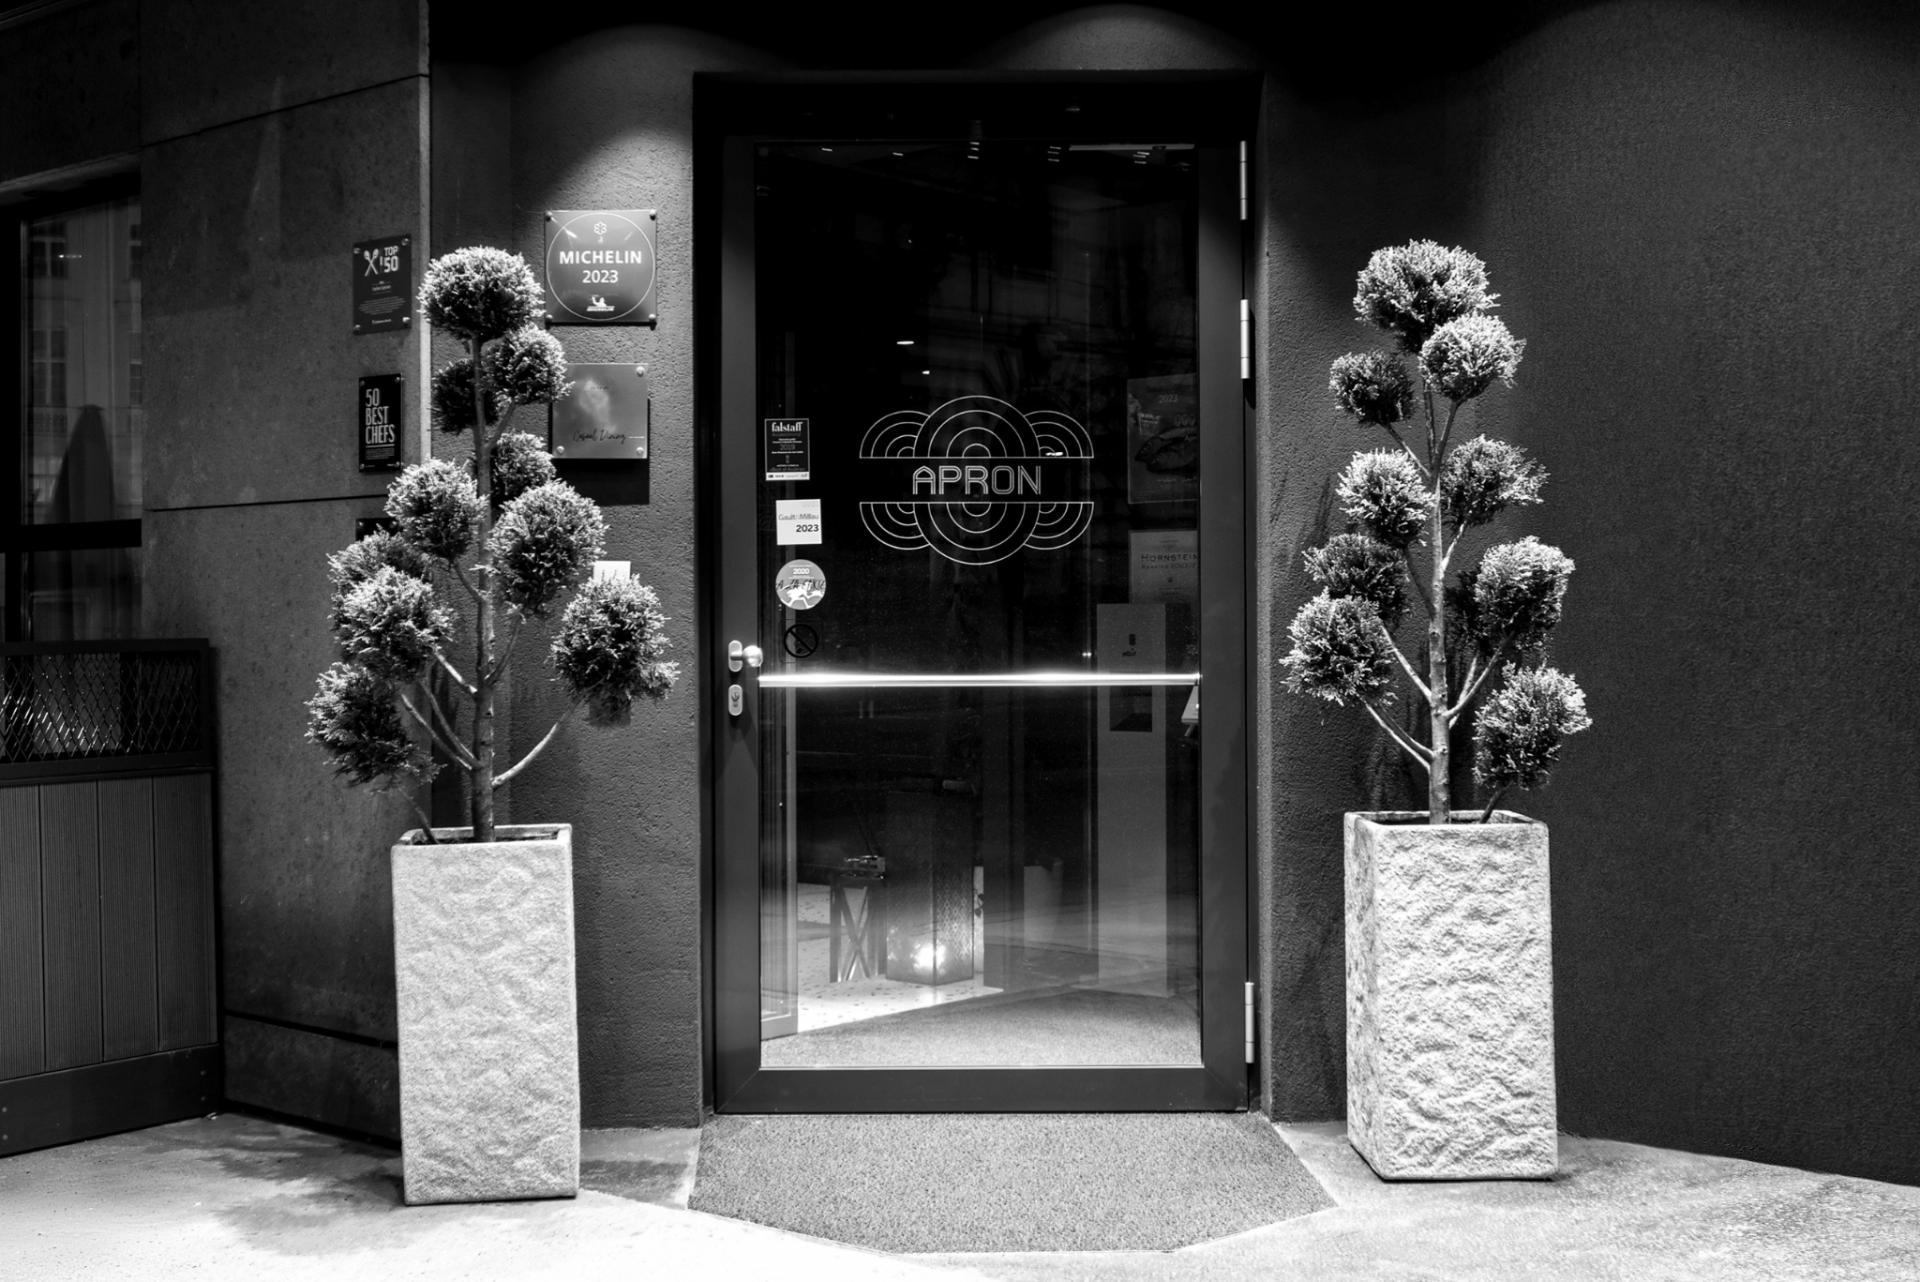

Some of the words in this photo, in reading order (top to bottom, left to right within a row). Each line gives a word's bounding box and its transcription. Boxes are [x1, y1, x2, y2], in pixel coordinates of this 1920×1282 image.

[383, 245, 400, 257] TOP
[559, 250, 642, 265] MICHELIN
[582, 269, 619, 284] 2023
[365, 387, 381, 407] 50
[1158, 393, 1180, 405] 2023
[365, 405, 390, 426] BEST
[771, 421, 804, 432] falstaff
[365, 423, 396, 444] CHEFS
[912, 465, 1042, 496] APRON
[796, 523, 820, 533] 2023
[1140, 553, 1198, 563] HORNSTEIN
[792, 567, 810, 576] 2020
